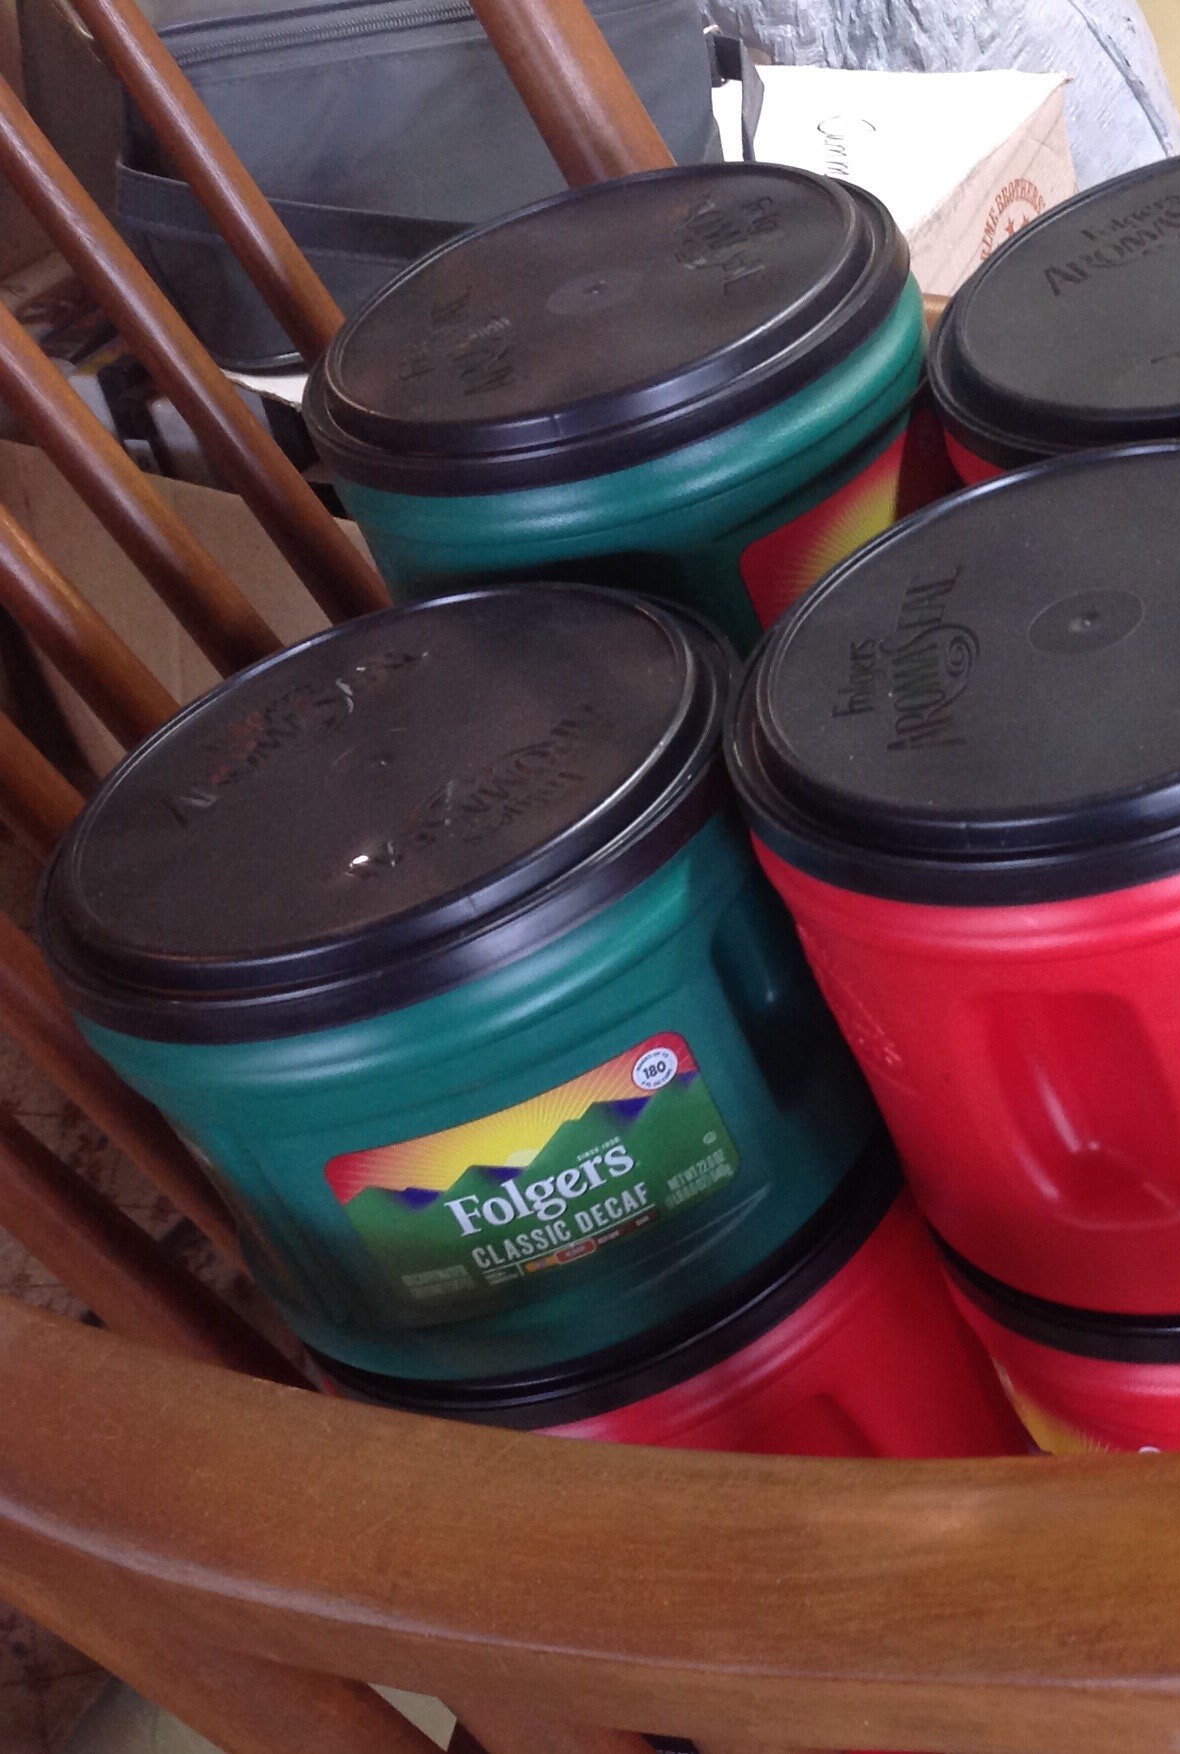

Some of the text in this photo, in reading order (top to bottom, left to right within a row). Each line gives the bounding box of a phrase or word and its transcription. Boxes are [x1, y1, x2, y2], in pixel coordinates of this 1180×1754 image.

[642, 1060, 667, 1080] 180
[443, 1143, 636, 1237] Folgers
[470, 1218, 573, 1270] CLASSIC
[574, 1182, 651, 1234] DECAF
